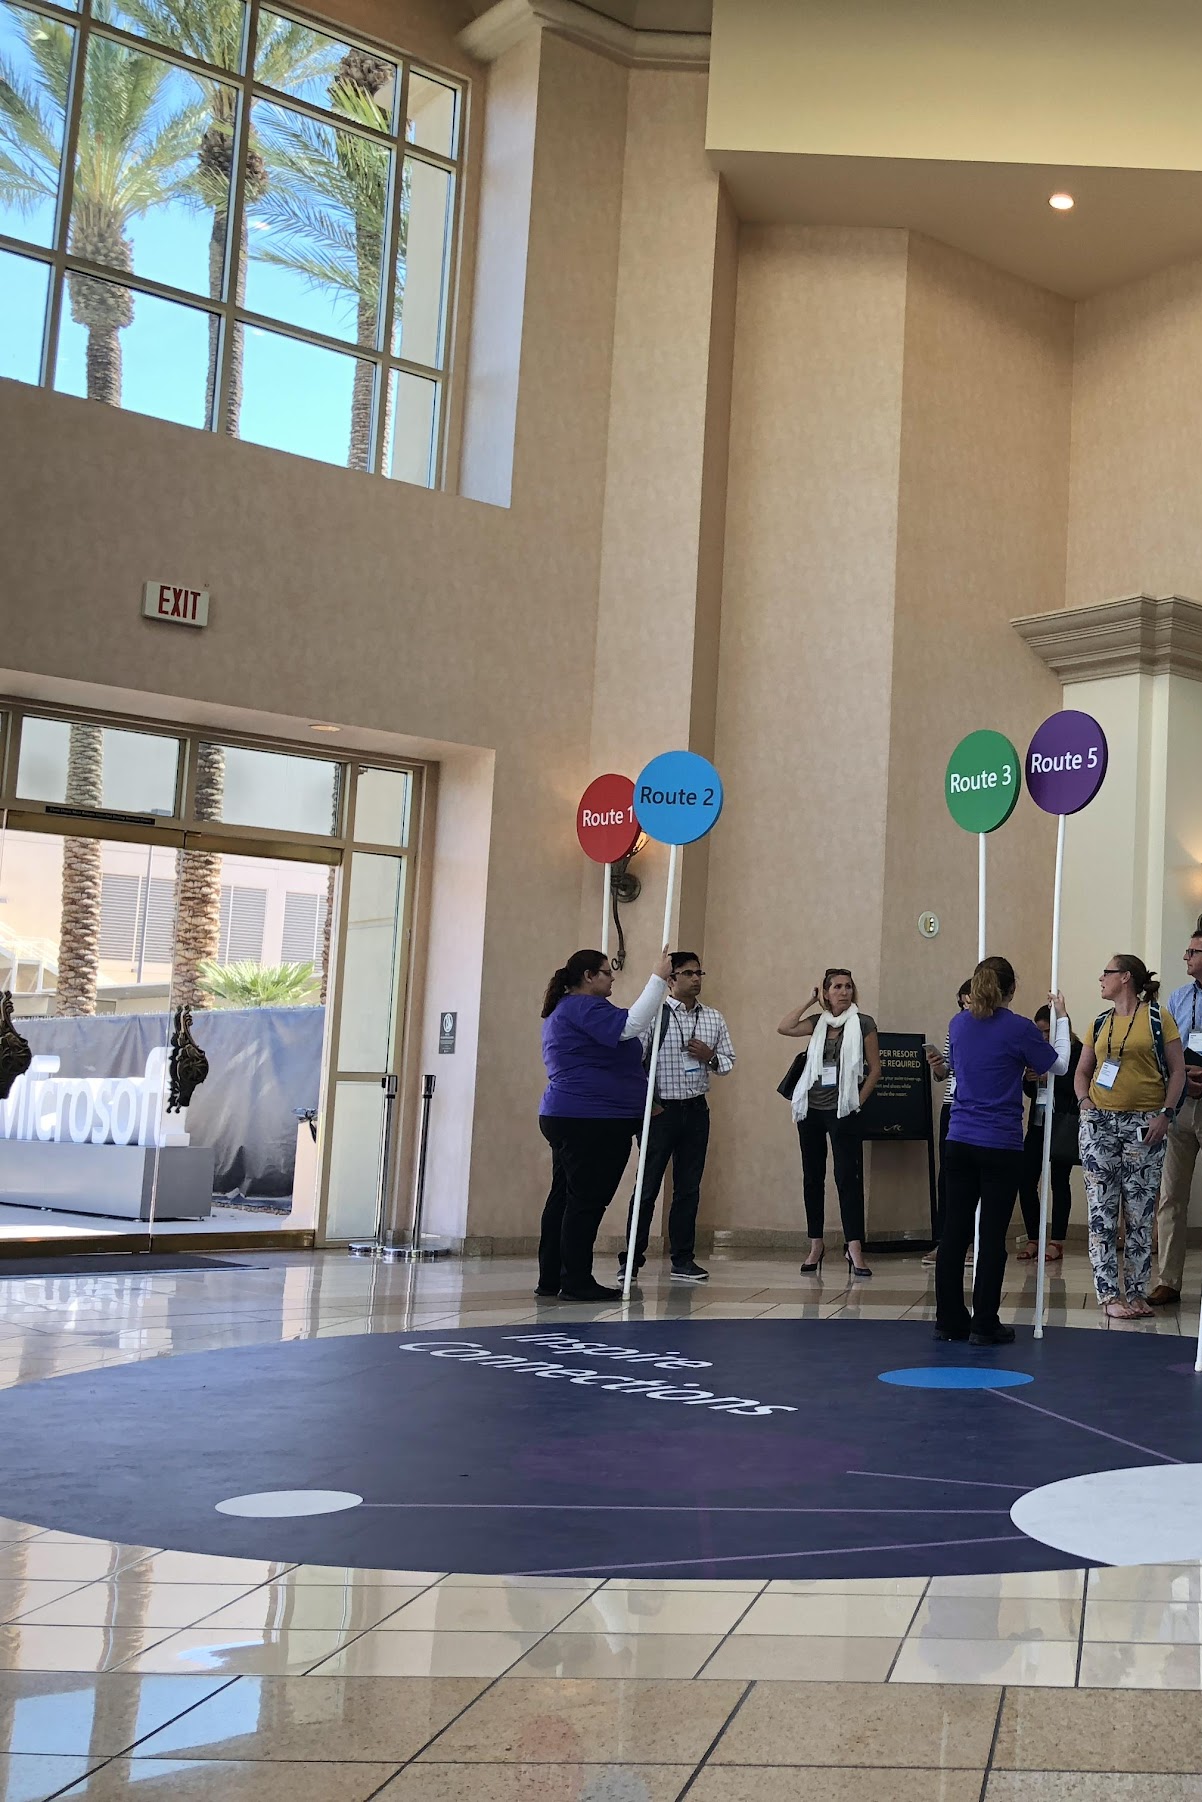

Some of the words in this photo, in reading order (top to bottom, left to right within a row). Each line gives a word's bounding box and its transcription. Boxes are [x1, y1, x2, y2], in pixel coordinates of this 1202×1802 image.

[158, 585, 201, 620] EXIT
[1031, 751, 1083, 774] Route
[1087, 747, 1099, 768] 5
[950, 770, 998, 794] Route
[1002, 765, 1012, 786] 3
[640, 786, 698, 806] Route
[702, 788, 714, 806] 2
[582, 808, 624, 827] Route
[627, 805, 634, 823] 1
[879, 1049, 892, 1058] PER
[893, 1050, 918, 1058] RESORT
[887, 1060, 921, 1068] REQUIRED
[501, 1332, 714, 1370] Inspire
[399, 1341, 799, 1416] Connections
